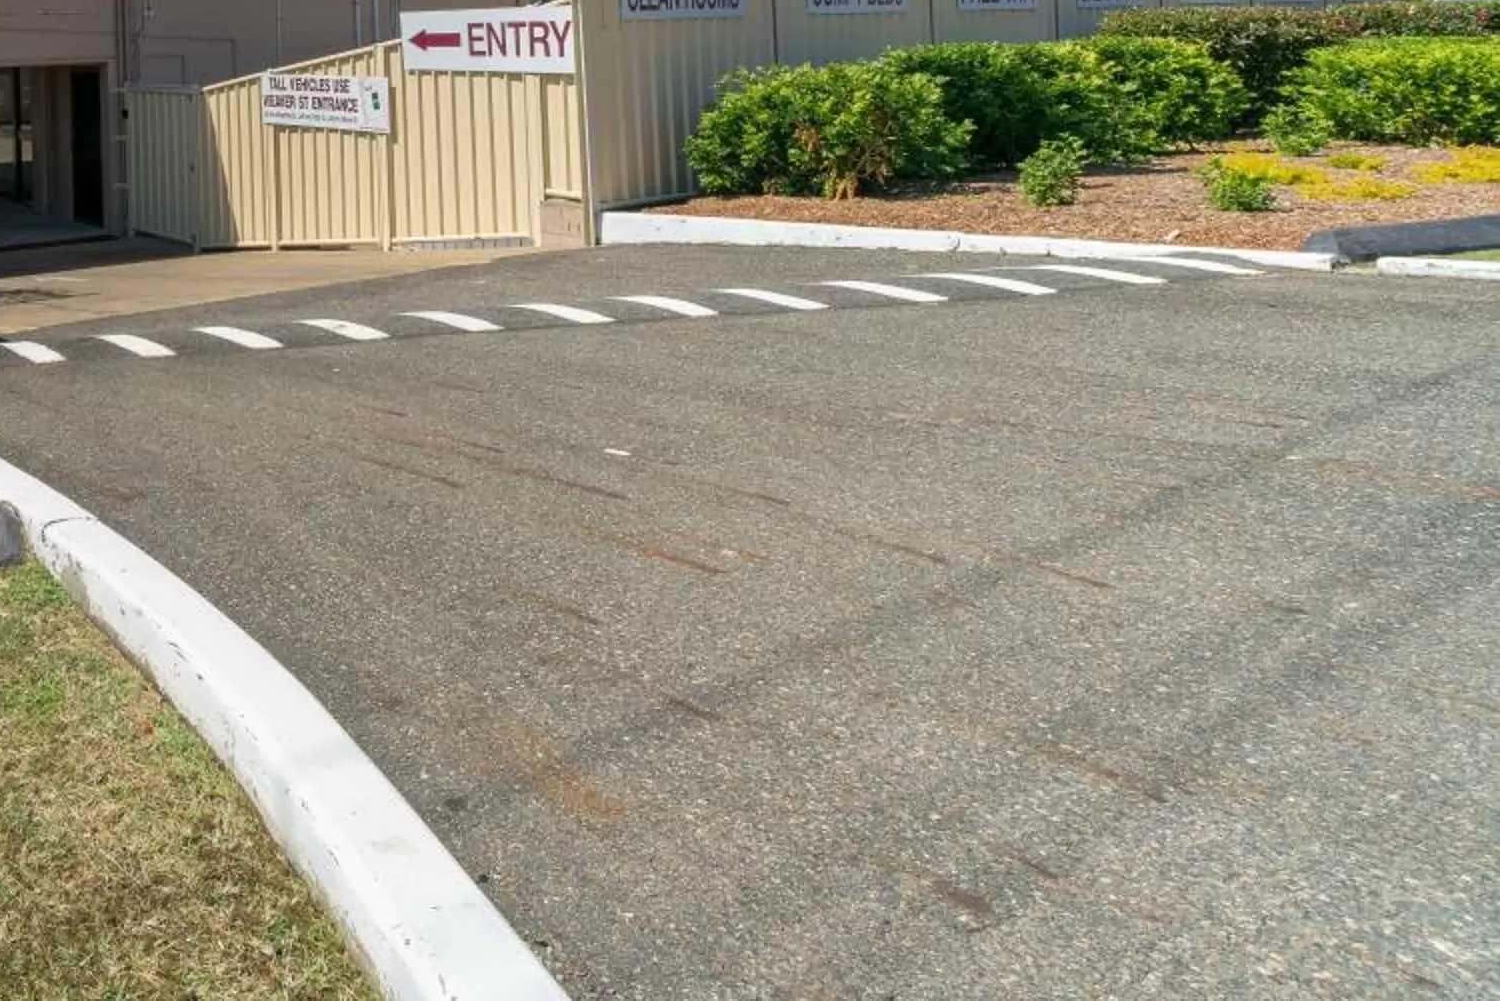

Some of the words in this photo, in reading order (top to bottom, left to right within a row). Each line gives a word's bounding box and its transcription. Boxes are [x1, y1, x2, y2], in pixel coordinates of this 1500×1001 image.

[467, 20, 572, 58] ENTRY
[269, 76, 287, 92] TALL
[289, 77, 331, 93] VEHICLES
[332, 79, 351, 94] USE
[312, 96, 359, 113] ENTRANCE
